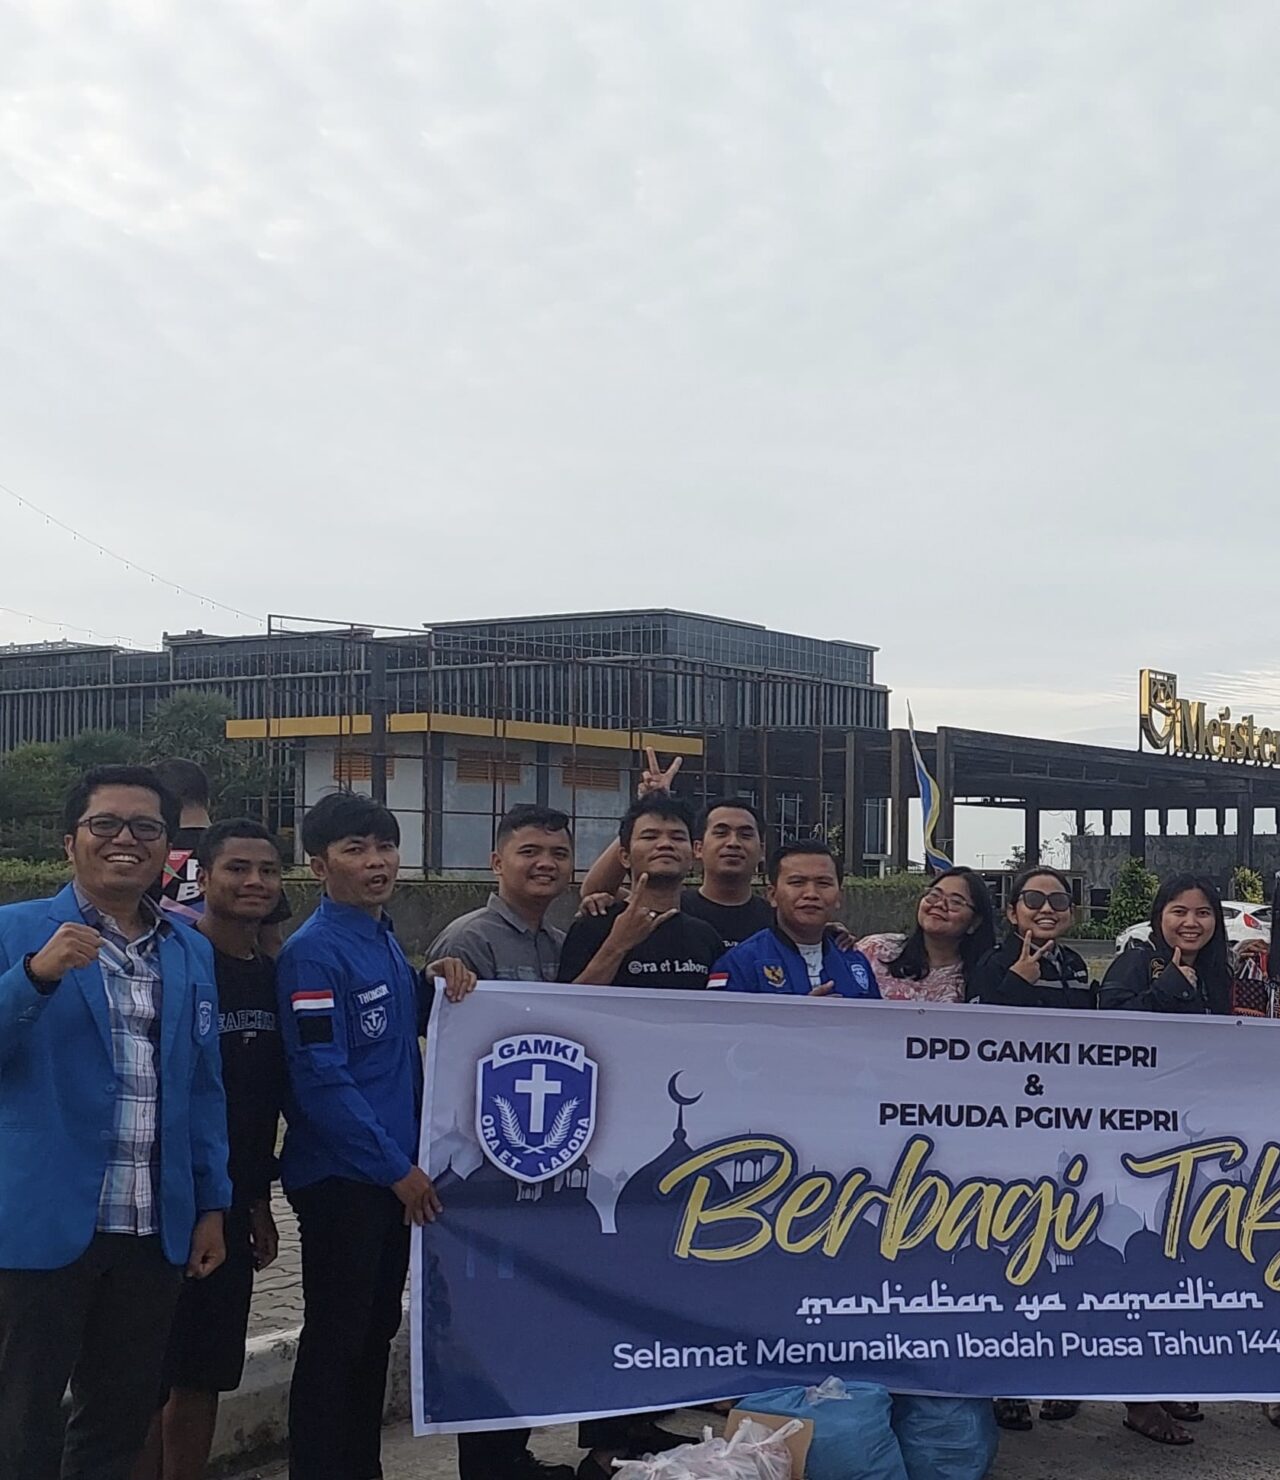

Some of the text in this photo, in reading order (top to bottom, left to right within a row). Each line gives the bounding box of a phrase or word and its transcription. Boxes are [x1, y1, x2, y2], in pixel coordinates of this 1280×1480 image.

[660, 959, 672, 973] et
[498, 1039, 579, 1063] GAMKI
[905, 1037, 1158, 1068] DPD GAMKI KEPRI
[1024, 1073, 1045, 1097] &
[879, 1102, 1179, 1132] PEMUDA PGIW KEPRI
[481, 1114, 590, 1173] ORA ET LABORA
[656, 1136, 1101, 1287] Berbagi
[796, 1276, 1264, 1324] marhaban ya ramadhan
[612, 1341, 747, 1369] Selamat
[756, 1333, 949, 1365] Menunaikan
[956, 1331, 1054, 1359] Ibadah
[1061, 1331, 1143, 1357] Puasa
[1147, 1330, 1233, 1355] Tahun
